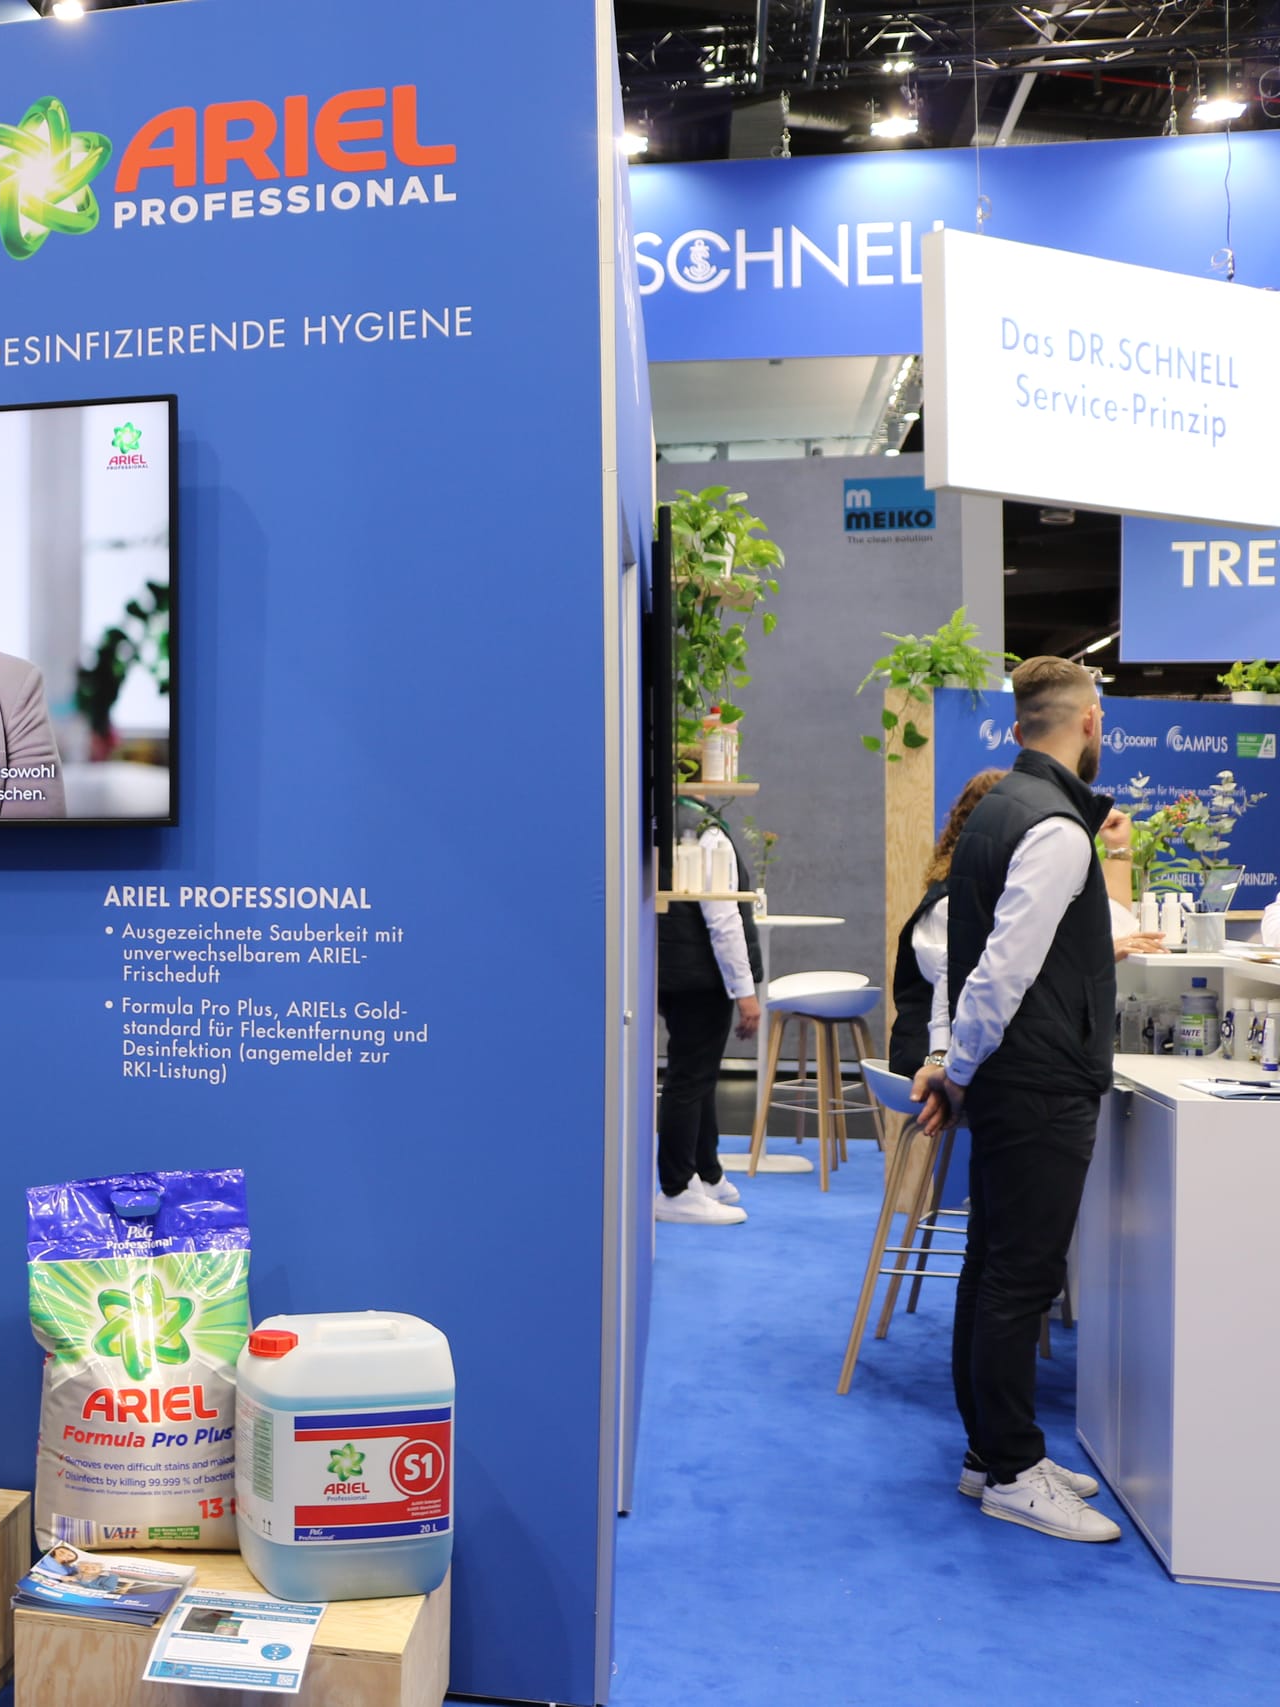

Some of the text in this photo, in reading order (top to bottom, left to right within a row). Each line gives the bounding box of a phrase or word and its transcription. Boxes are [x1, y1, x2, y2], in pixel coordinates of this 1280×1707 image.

[115, 85, 456, 192] ARIEL
[114, 171, 456, 229] PROFESSIONAL
[634, 220, 944, 295] SCHNEL
[304, 306, 472, 345] HYGIENE
[1002, 317, 1239, 388] Das DR.SCHNELL
[1016, 374, 1226, 448] Service-Prinzip
[109, 455, 146, 465] ARIEL
[1172, 540, 1280, 587] TRE
[0, 764, 55, 778] sowohl
[104, 886, 371, 909] ARIEL PROFESSIONAL
[122, 922, 403, 944] Ausgezeichnete Sauberkeit mit
[124, 944, 367, 963] unverwechselbarem ARIEL-
[124, 964, 220, 983] Frischeduft
[123, 996, 407, 1019] Formula Pro Plus, ARIELs Gold-
[124, 1018, 427, 1046] standard für Fleckentfernung und
[124, 1039, 389, 1065] Desinfektion (angemeldet zur
[124, 1061, 226, 1084] RKI-Listung)
[106, 1237, 172, 1250] Professional
[127, 1225, 153, 1239] P&G
[82, 1385, 218, 1423] ARIEL
[63, 1425, 145, 1448] Formula
[152, 1432, 188, 1448] Pro
[127, 1463, 161, 1472] difficult
[192, 1460, 208, 1468] and
[404, 1453, 433, 1481] S1
[65, 1471, 202, 1488] Disinfects by killing 99.999 of
[324, 1483, 370, 1494] ARIEL
[199, 1497, 224, 1519] 13
[420, 1525, 430, 1533] 20
